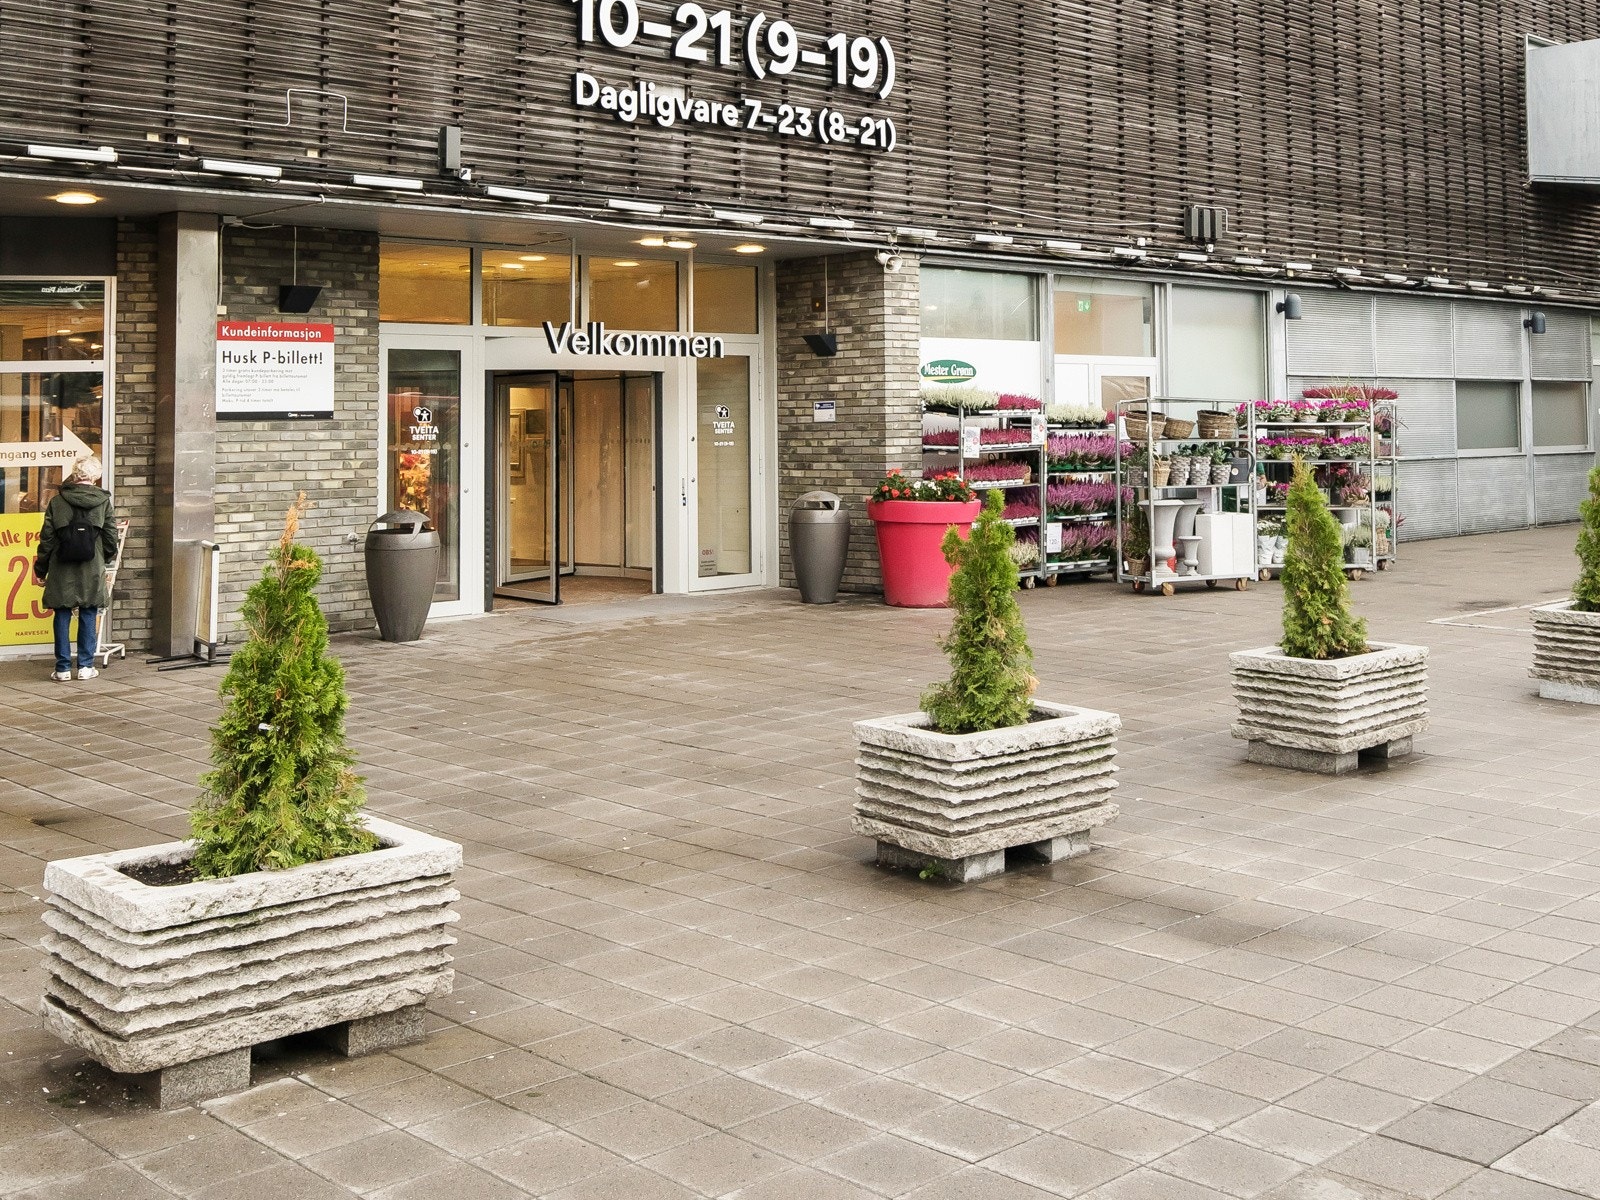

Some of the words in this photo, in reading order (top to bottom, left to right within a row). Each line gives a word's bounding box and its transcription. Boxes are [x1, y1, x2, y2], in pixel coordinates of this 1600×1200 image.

[574, 72, 739, 128] Dagligvare
[221, 325, 322, 340] Kundeinformasjon
[543, 321, 725, 359] Velkommen
[222, 349, 257, 364] Husk
[263, 350, 323, 365] P-billett!
[924, 363, 949, 376] Mester
[409, 425, 439, 435] TVEITA
[712, 421, 735, 429] TVEITA
[41, 449, 77, 458] senter
[15, 629, 49, 637] NARVESEN
